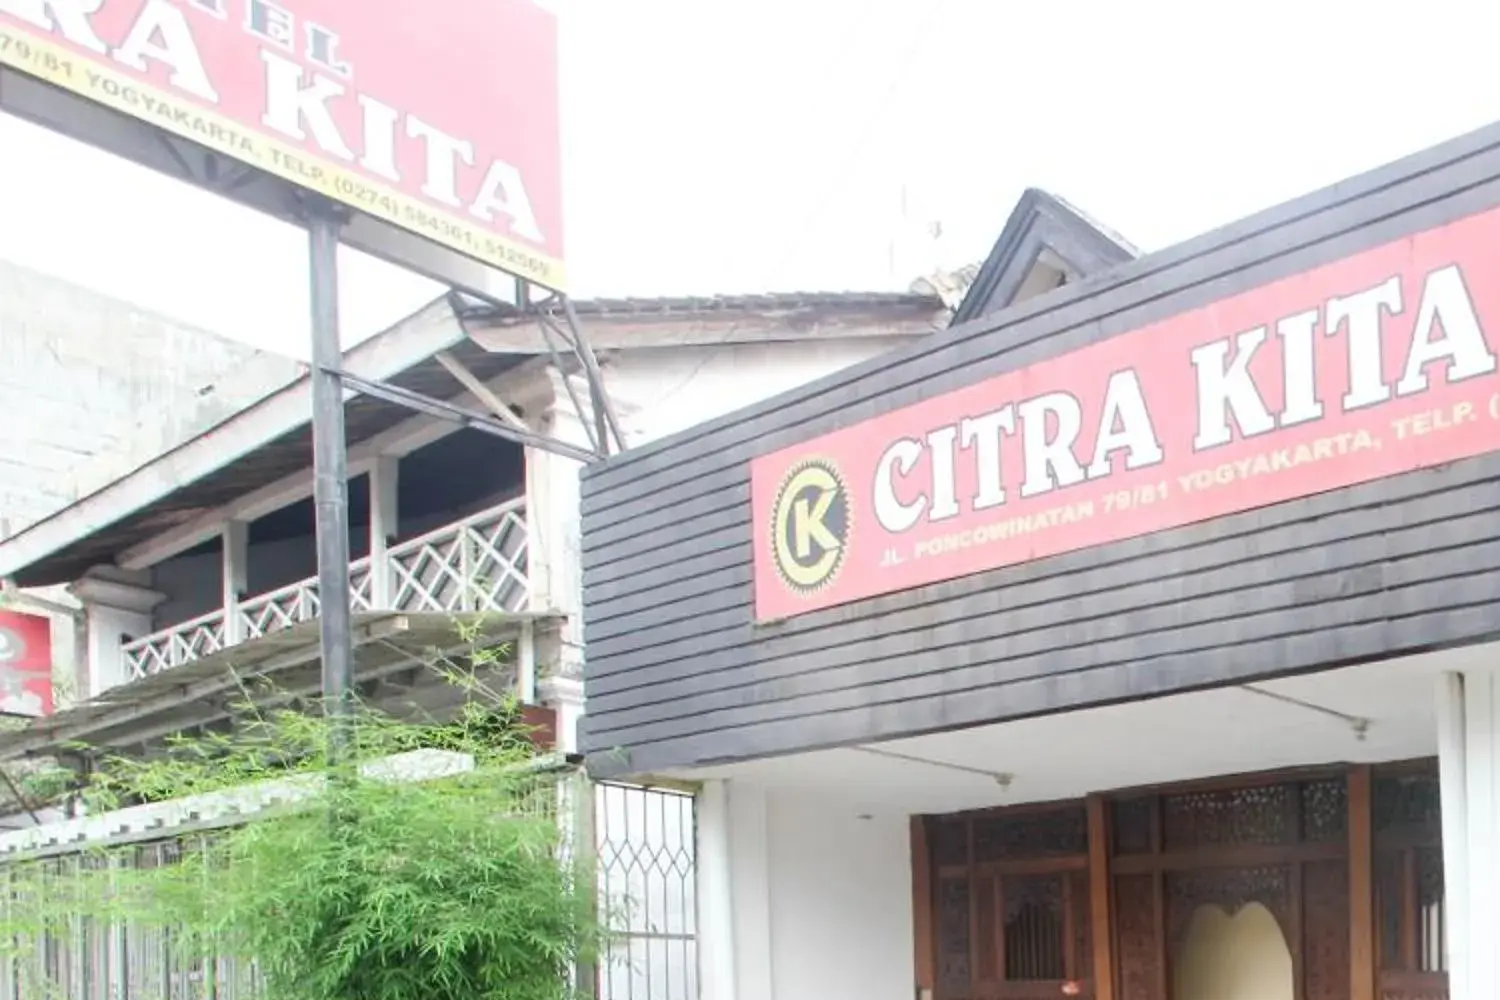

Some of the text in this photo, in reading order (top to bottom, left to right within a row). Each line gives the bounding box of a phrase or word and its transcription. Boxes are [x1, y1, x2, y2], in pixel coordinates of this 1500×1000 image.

[191, 0, 353, 82] EL
[85, 68, 262, 159] YOGYAKARTA,
[269, 146, 328, 186] TELP.
[334, 174, 399, 216] (0274)
[259, 47, 546, 244] KITA
[872, 367, 1163, 533] CITRA
[1189, 262, 1498, 454] KITA
[914, 500, 1094, 558] PONCOWINATAN
[1102, 482, 1168, 514] 79/81
[1177, 428, 1382, 494] YOGYAKARTA,
[1392, 401, 1478, 441] TELP.
